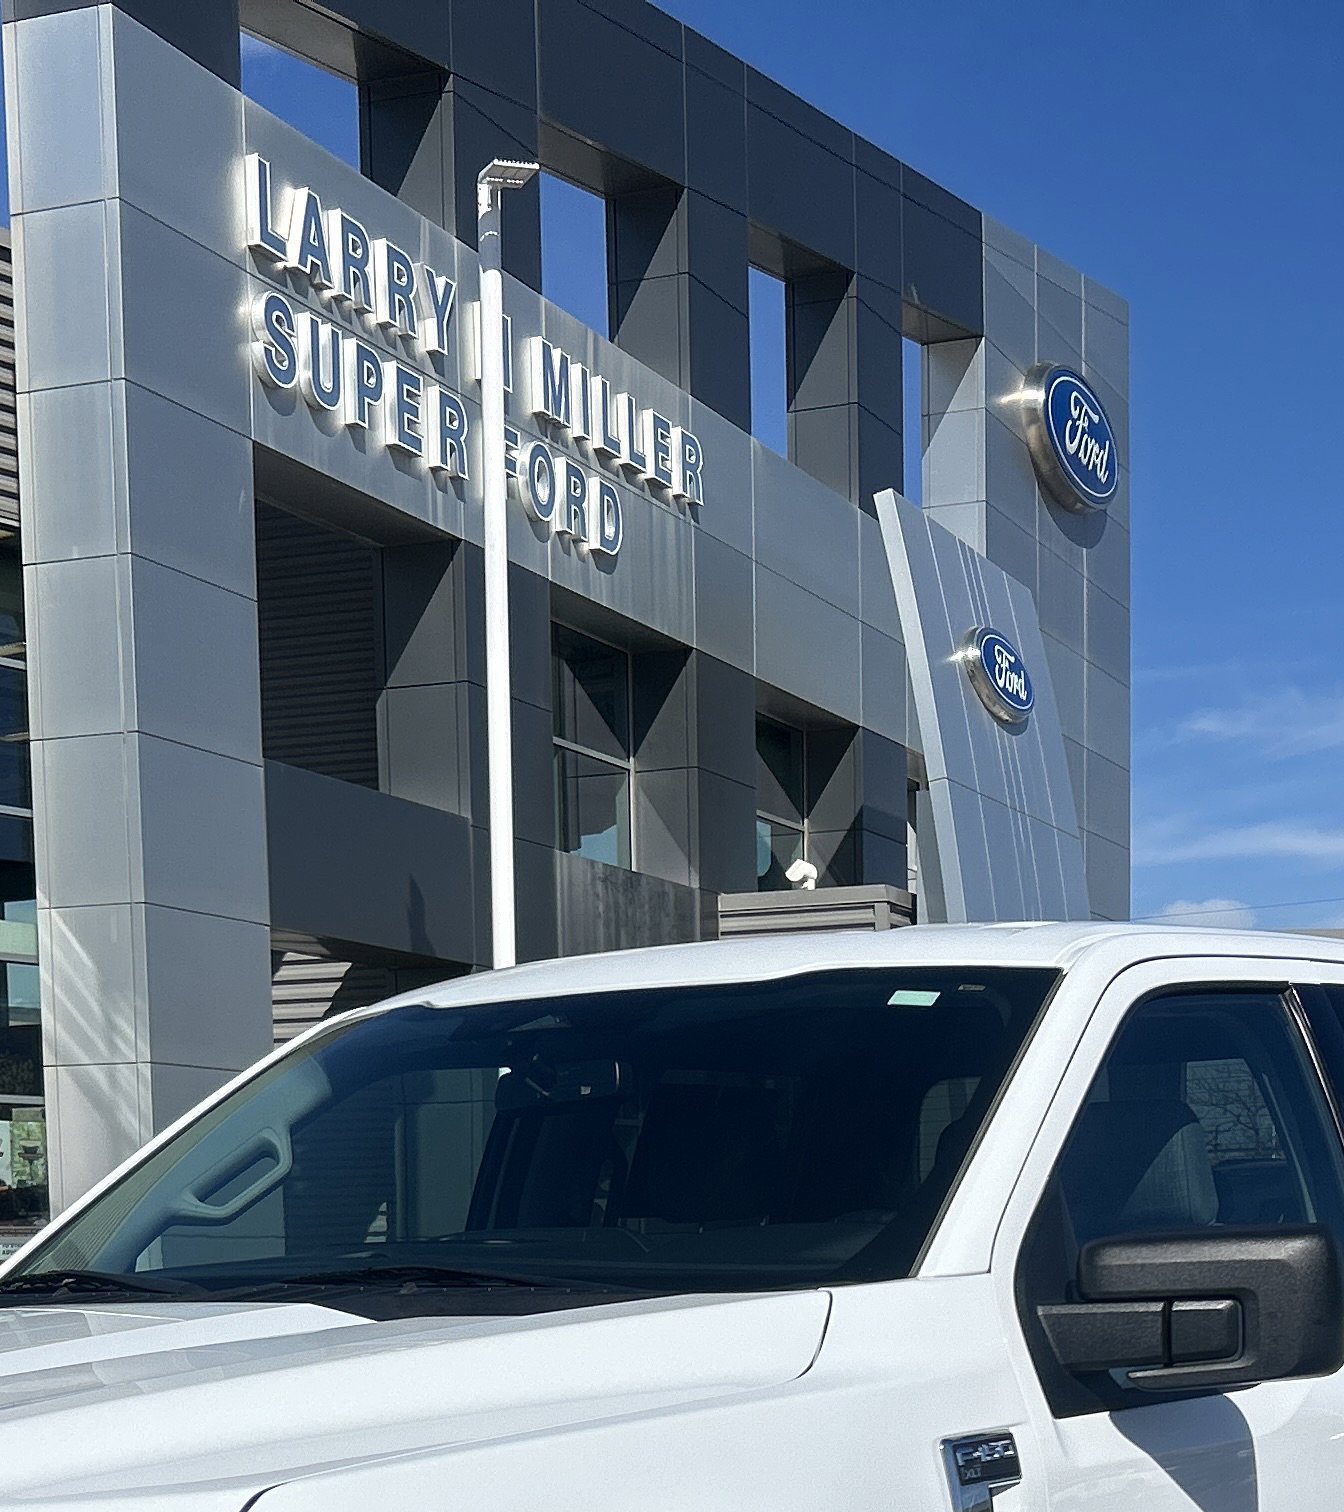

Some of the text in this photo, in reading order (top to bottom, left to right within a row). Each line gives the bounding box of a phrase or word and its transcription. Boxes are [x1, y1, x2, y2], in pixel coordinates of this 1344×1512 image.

[246, 153, 457, 356] LARRY
[530, 336, 704, 506] MILLER
[252, 291, 470, 481] SUPER
[1064, 390, 1109, 484] Ford
[994, 643, 1028, 701] Ford
[960, 1467, 982, 1479] XLT
